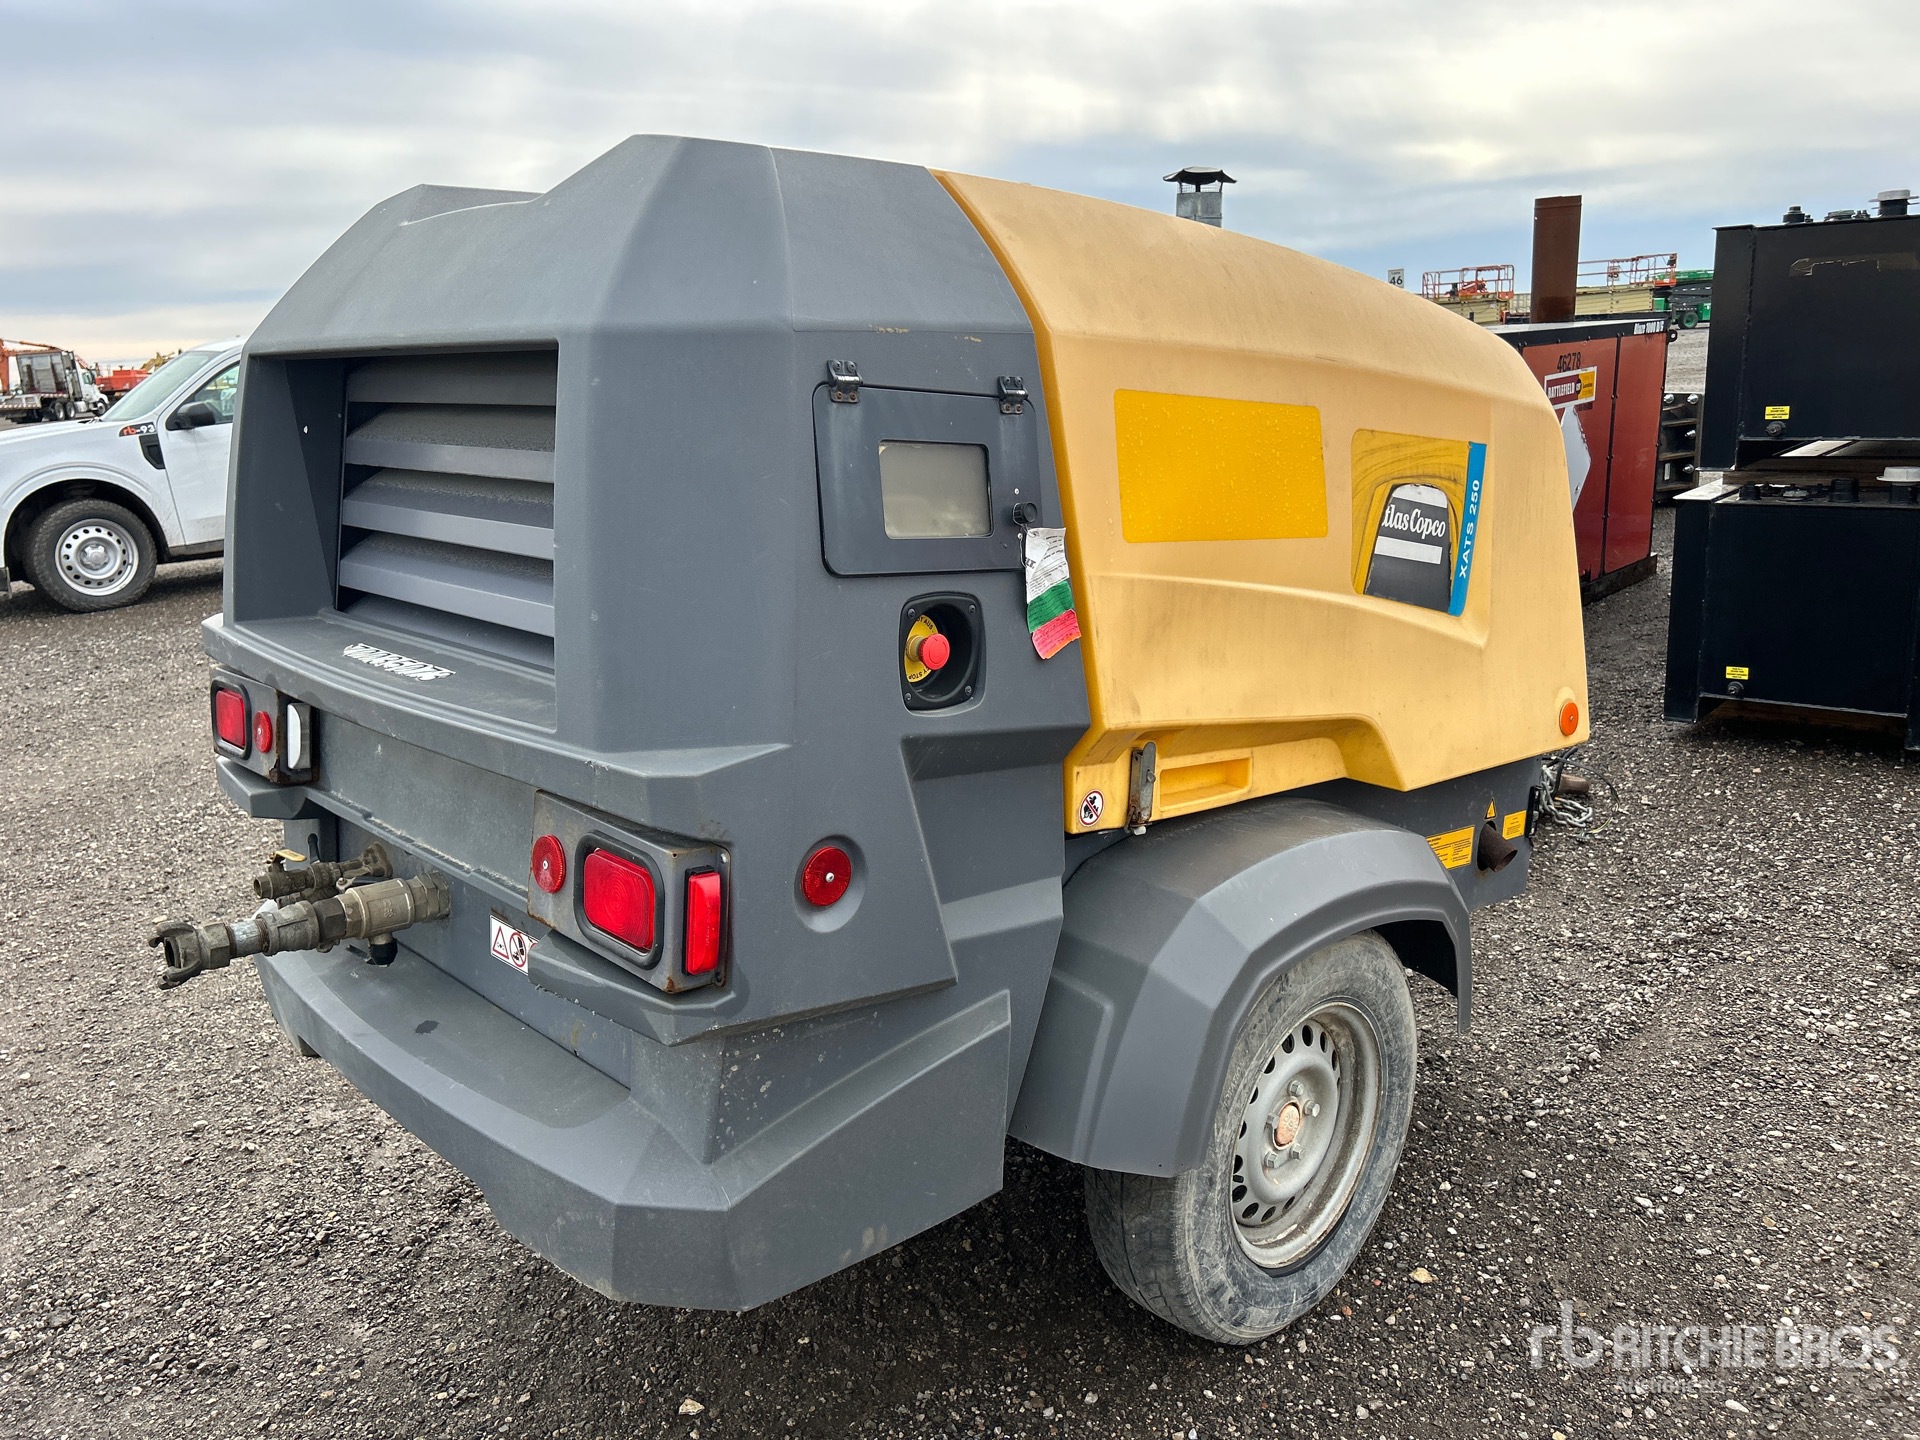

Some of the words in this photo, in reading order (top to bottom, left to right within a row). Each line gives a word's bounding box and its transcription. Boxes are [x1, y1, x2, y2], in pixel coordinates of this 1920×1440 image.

[1389, 275, 1403, 286] 46
[1556, 351, 1582, 373] 46278
[1547, 381, 1576, 399] BATTLEFIELD
[1381, 504, 1410, 531] tlas
[1409, 508, 1446, 539] Copco
[1459, 522, 1474, 578] XATS
[1469, 479, 1480, 516] 250
